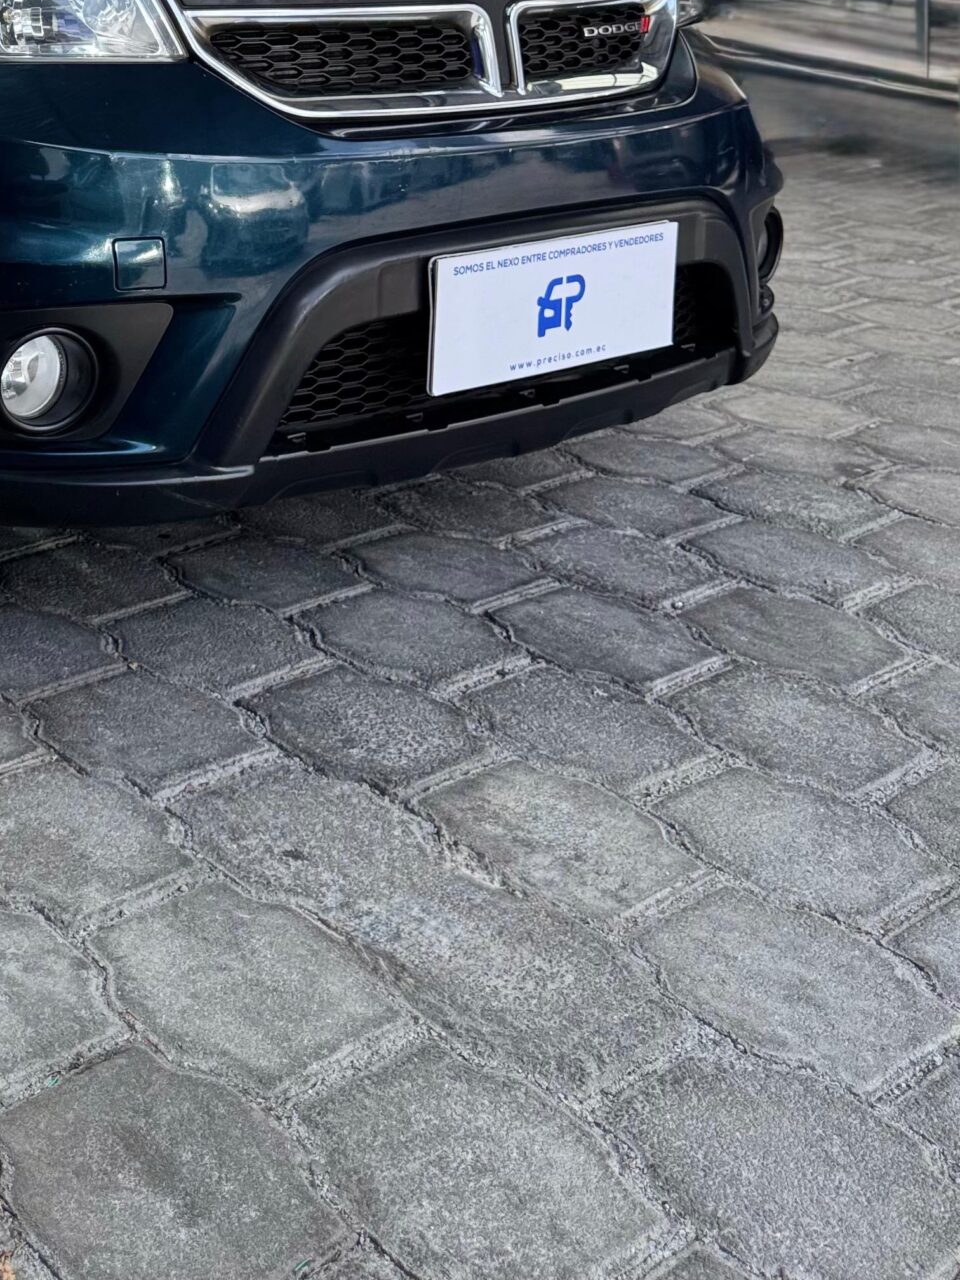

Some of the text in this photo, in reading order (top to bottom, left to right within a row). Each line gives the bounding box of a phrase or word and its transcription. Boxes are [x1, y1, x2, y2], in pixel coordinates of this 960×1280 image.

[583, 21, 642, 37] DODGE
[453, 232, 664, 276] SOMOS EL NEXO ENTRE COMPRADORES Y VENDEDORES
[509, 344, 607, 372] www.preciso.com.ec
